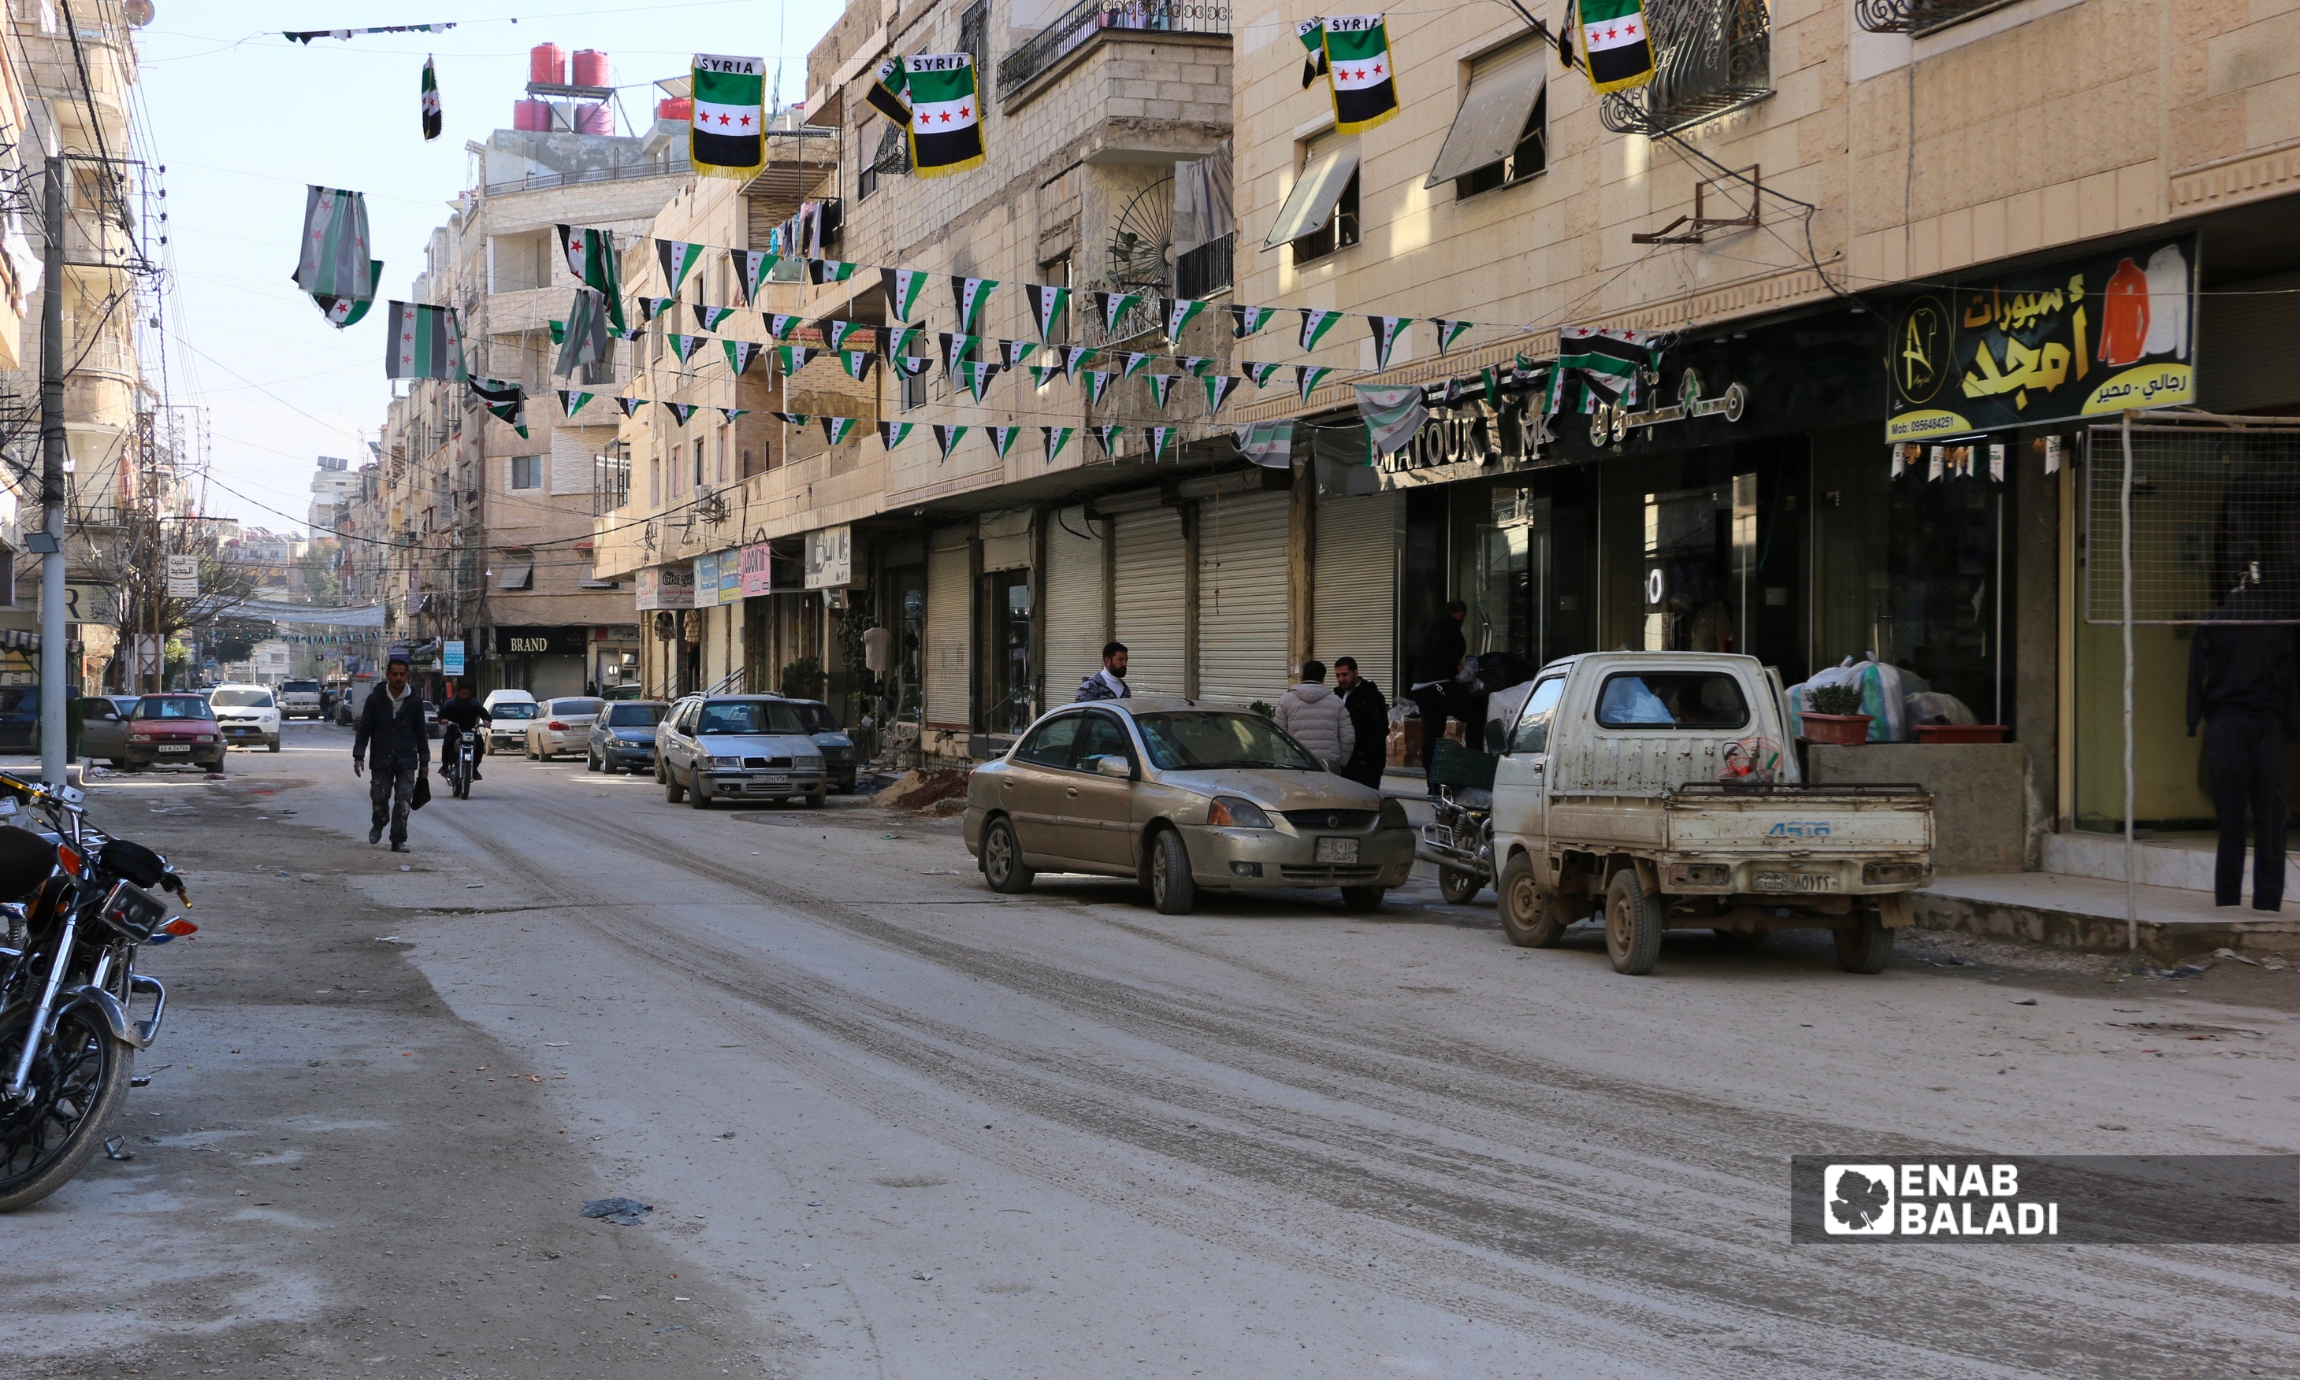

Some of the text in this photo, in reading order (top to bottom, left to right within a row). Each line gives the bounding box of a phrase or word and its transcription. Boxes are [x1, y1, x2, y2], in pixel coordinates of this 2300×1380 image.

[1332, 18, 1378, 31] SYRIA
[701, 58, 754, 74] SYRIA
[913, 57, 965, 71] SYRIA
[2143, 373, 2187, 400] رجالي
[1891, 422, 1910, 435] Mob:
[510, 637, 548, 652] BRAND
